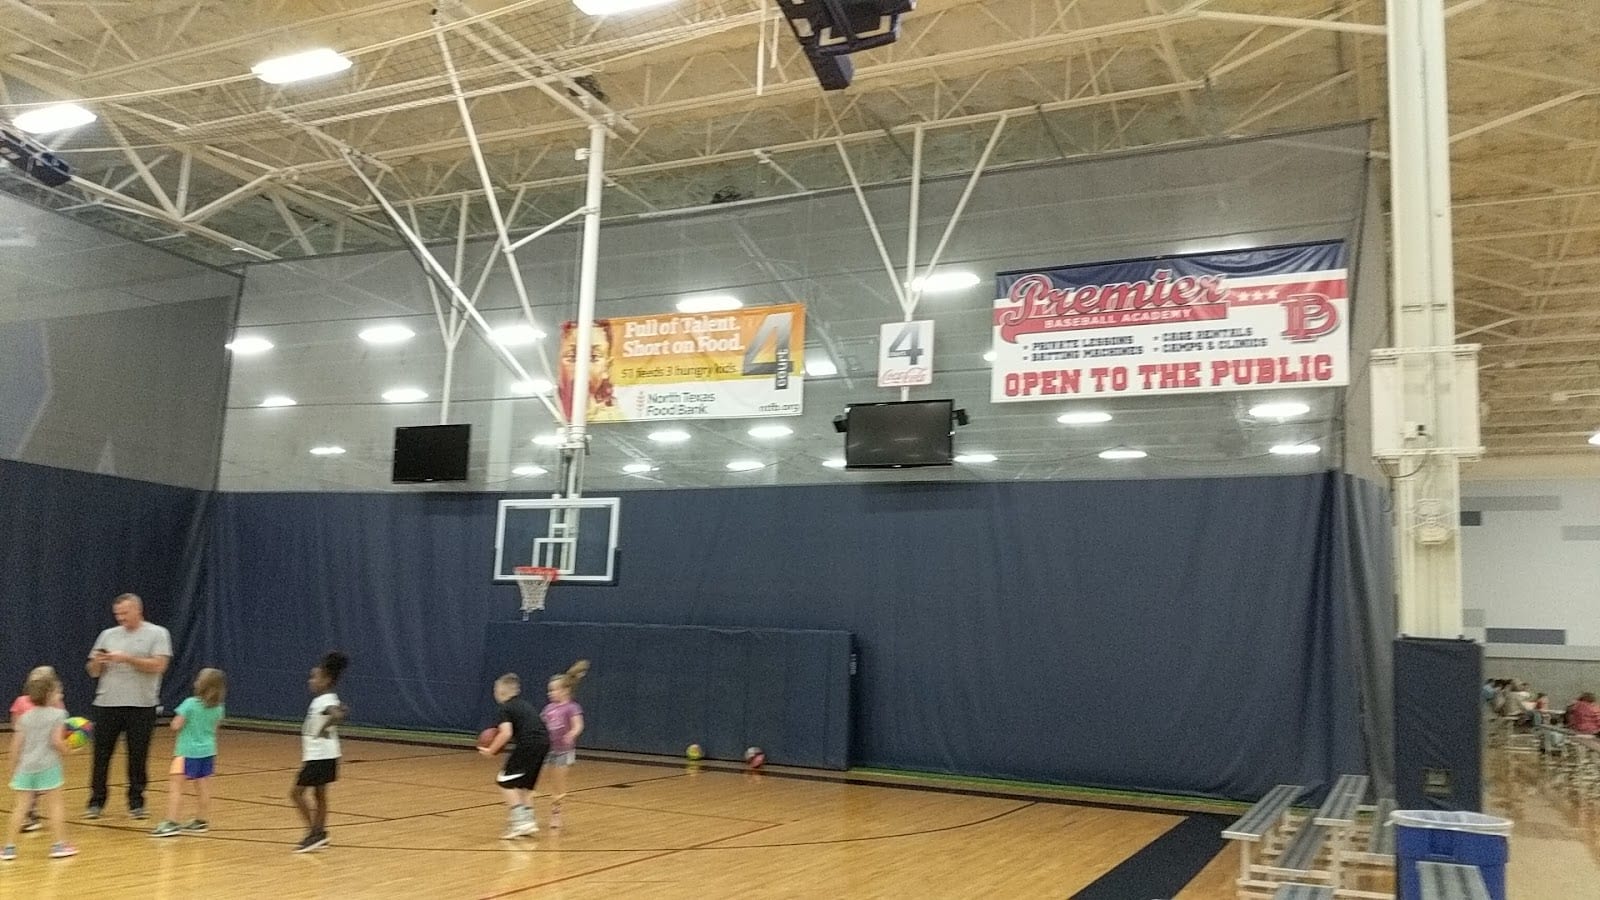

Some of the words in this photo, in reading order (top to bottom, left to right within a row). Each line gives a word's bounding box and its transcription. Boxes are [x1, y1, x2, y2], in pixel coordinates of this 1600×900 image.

[1001, 268, 1228, 326] Premier
[624, 319, 658, 338] Full
[659, 317, 679, 335] of
[680, 315, 741, 333] Talent.
[1044, 315, 1117, 330] BASEBALL
[1121, 308, 1193, 323] ACADEMY
[743, 312, 793, 376] 4
[888, 323, 924, 365] 4
[1032, 339, 1079, 351] PRIVATE
[1082, 335, 1134, 348] LESSONS
[1162, 331, 1193, 342] CAGE
[1196, 327, 1253, 340] RENTALS
[622, 339, 670, 358] Short
[672, 339, 695, 354] on
[696, 335, 745, 353] Food.
[1031, 350, 1079, 361] BATTING
[1082, 345, 1144, 359] MACHINES
[1162, 341, 1204, 353] CAMPS
[1218, 338, 1268, 350] CLINICS
[635, 366, 664, 378] feeds
[666, 365, 673, 376] 3
[675, 364, 714, 379] hungry
[1004, 368, 1081, 397] OPEN
[1090, 365, 1129, 392] TO
[1138, 361, 1201, 390] THE
[1210, 354, 1333, 386] PUBLIC
[647, 392, 681, 405] North
[682, 391, 716, 403] Texas
[647, 404, 677, 417] Food
[678, 403, 709, 416] Bank
